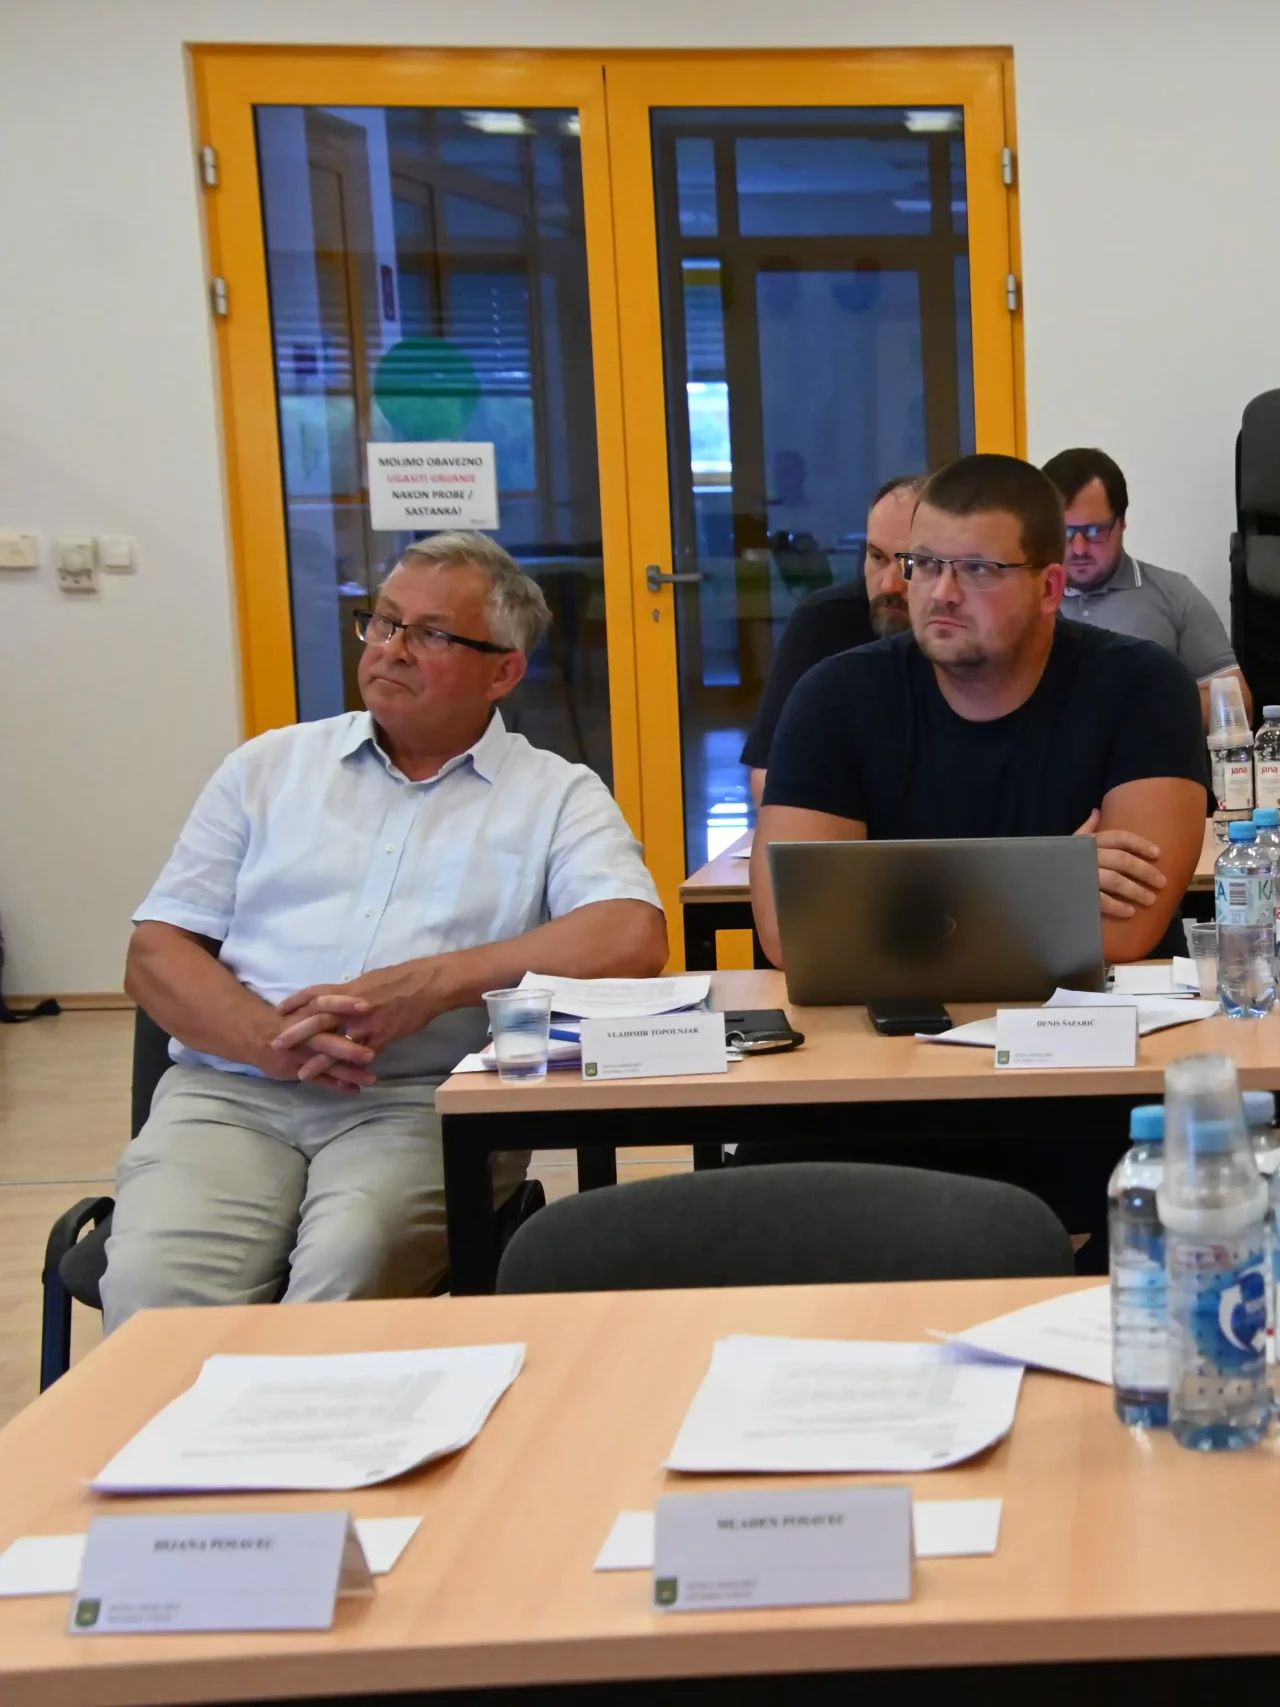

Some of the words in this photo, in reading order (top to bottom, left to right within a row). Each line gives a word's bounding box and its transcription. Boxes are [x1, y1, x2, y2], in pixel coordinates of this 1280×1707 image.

[378, 457, 424, 467] MOLIMO
[426, 457, 483, 466] OBAVEZNO
[392, 490, 429, 499] NAKON
[432, 490, 465, 499] PROBE
[404, 506, 462, 516] SASTANKA!
[606, 1030, 649, 1039] VLADIMIR
[650, 1027, 699, 1036] TOPOLNJAK
